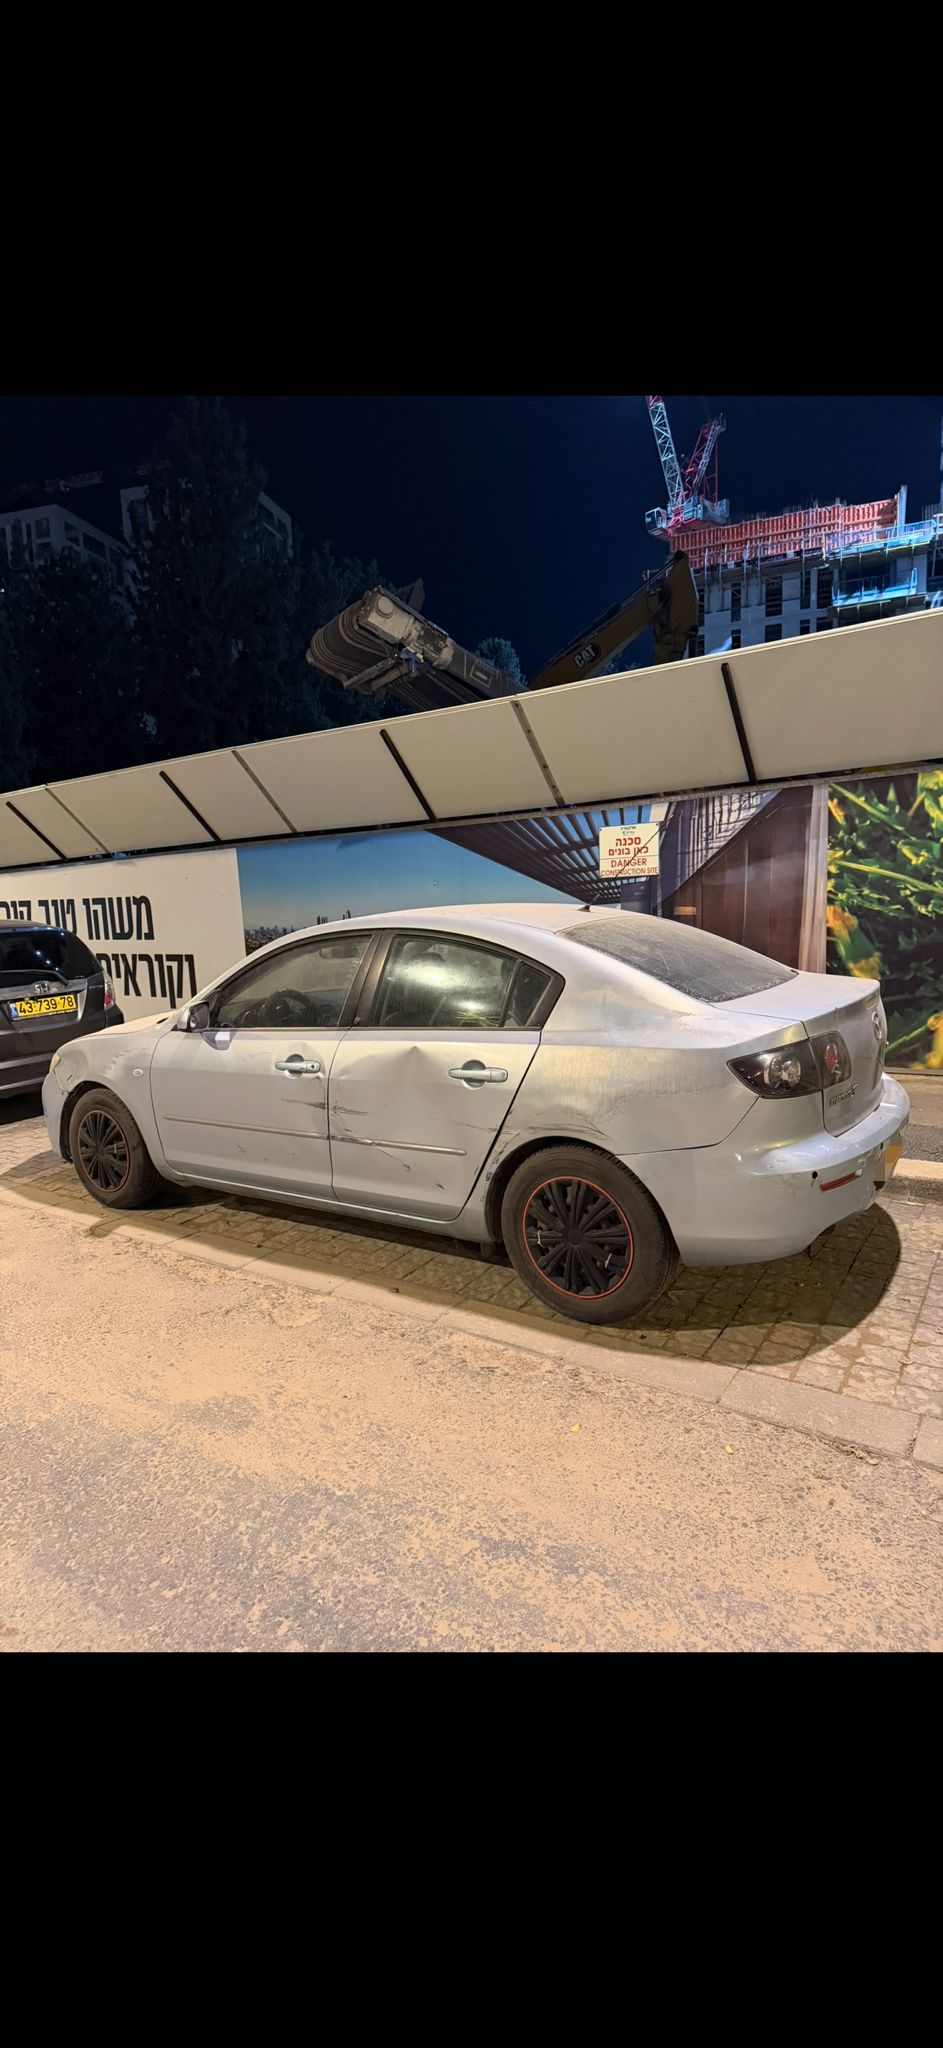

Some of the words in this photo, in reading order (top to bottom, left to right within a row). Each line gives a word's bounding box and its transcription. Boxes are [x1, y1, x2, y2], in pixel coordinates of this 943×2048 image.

[574, 644, 595, 668] CAT
[615, 837, 641, 847] סכנה
[608, 847, 631, 856] בונים
[633, 846, 649, 856] כאן
[611, 858, 647, 868] DANGER
[601, 868, 646, 877] CONSTRUCTION
[82, 895, 155, 940] משהו
